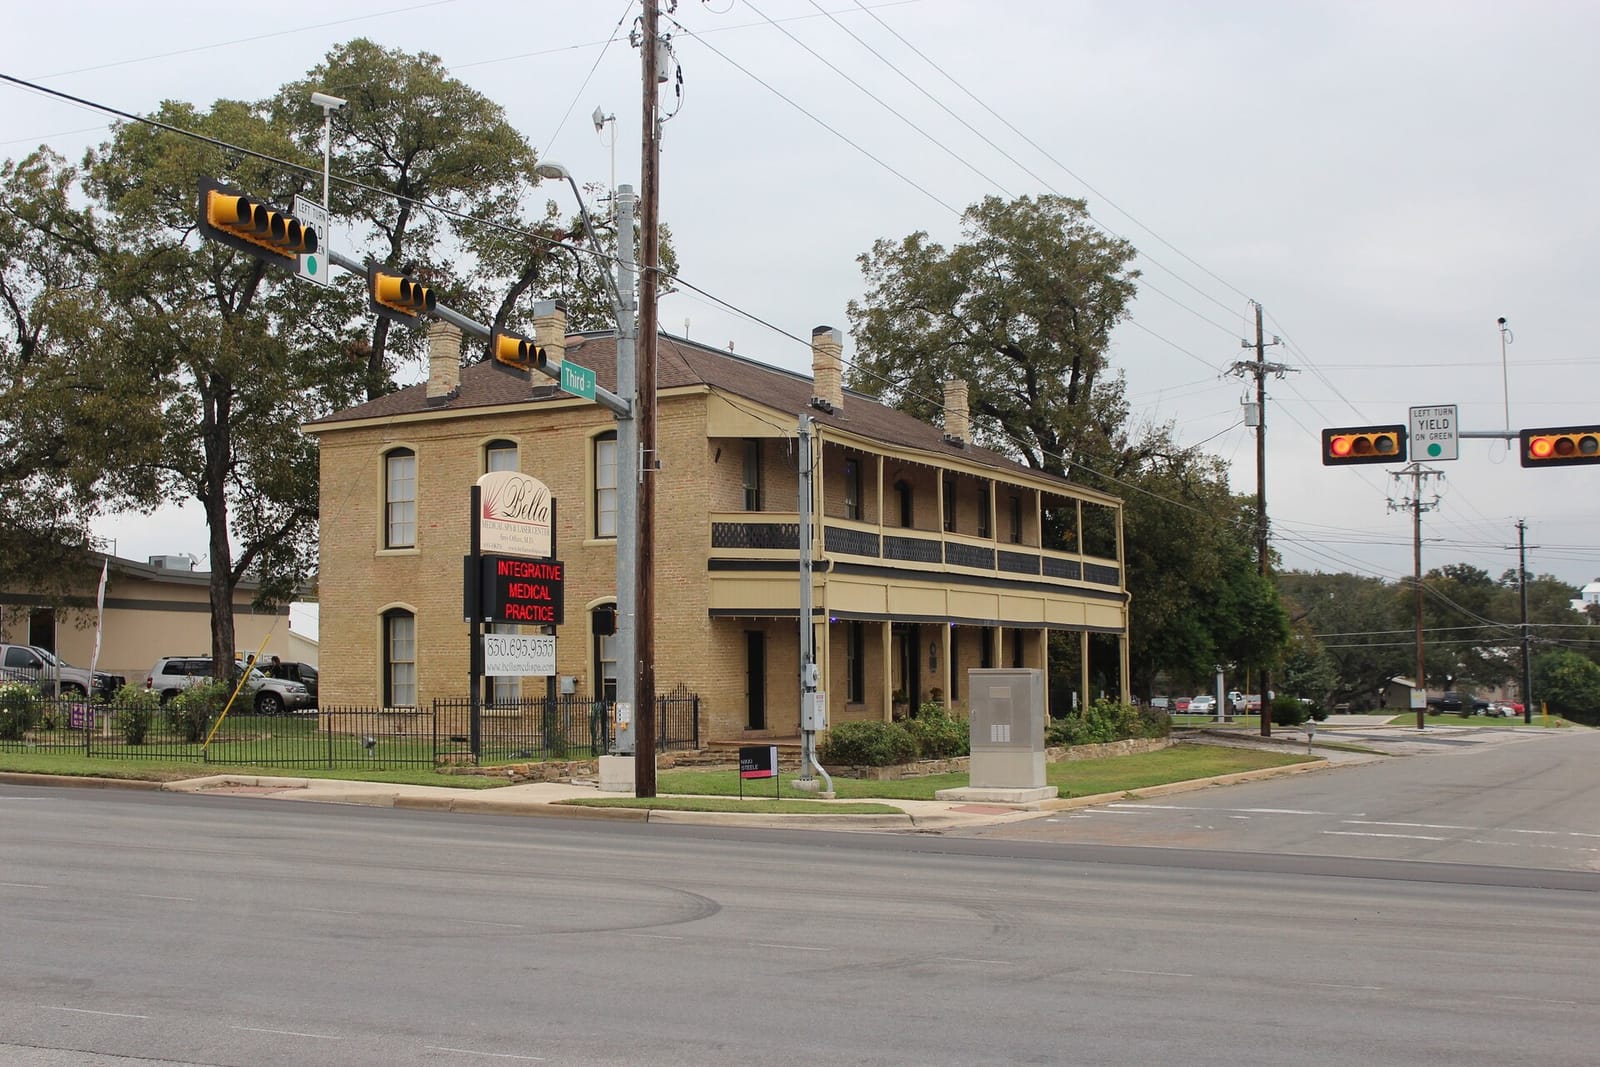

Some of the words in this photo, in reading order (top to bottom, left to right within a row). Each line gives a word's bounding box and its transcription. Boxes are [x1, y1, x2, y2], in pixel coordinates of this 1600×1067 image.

[298, 202, 310, 215] LEFT
[313, 208, 326, 222] TURN
[565, 367, 585, 391] Third
[1413, 409, 1430, 417] LEFT
[1434, 408, 1453, 416] TURN
[1418, 419, 1449, 430] YIELD
[1415, 433, 1425, 441] ON
[1429, 432, 1452, 440] GREEN
[502, 477, 549, 522] Bella
[498, 560, 561, 580] INTEGRATIVE
[509, 583, 551, 600] MEDICAL
[506, 604, 554, 621] PRACTICE
